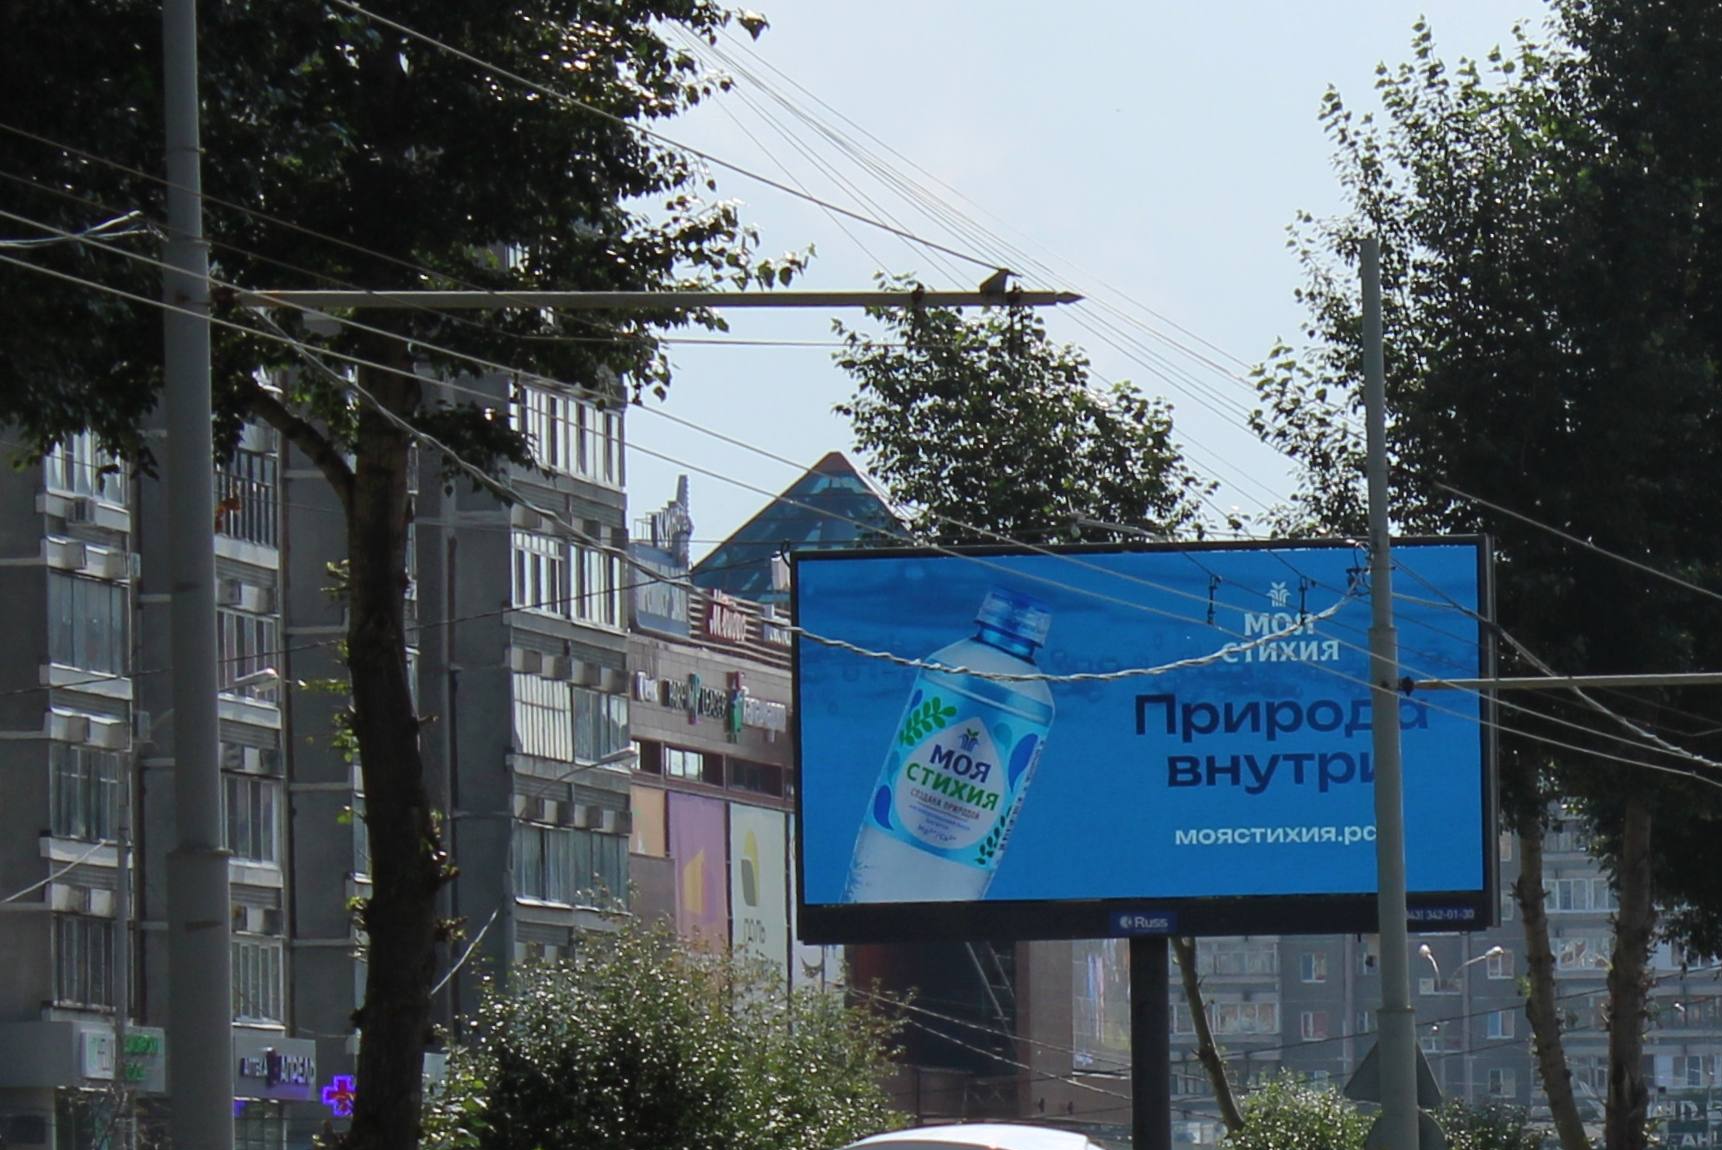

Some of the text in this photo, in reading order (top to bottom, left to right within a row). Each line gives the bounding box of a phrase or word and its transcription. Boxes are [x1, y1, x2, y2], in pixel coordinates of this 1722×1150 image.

[1244, 612, 1314, 636] МОЯ
[1221, 640, 1340, 663] СТИХИЯ
[1135, 694, 1428, 743] Природа
[929, 744, 992, 783] МОЯ
[906, 763, 1000, 811] СТИХИЯ
[1134, 916, 1169, 929] Russ
